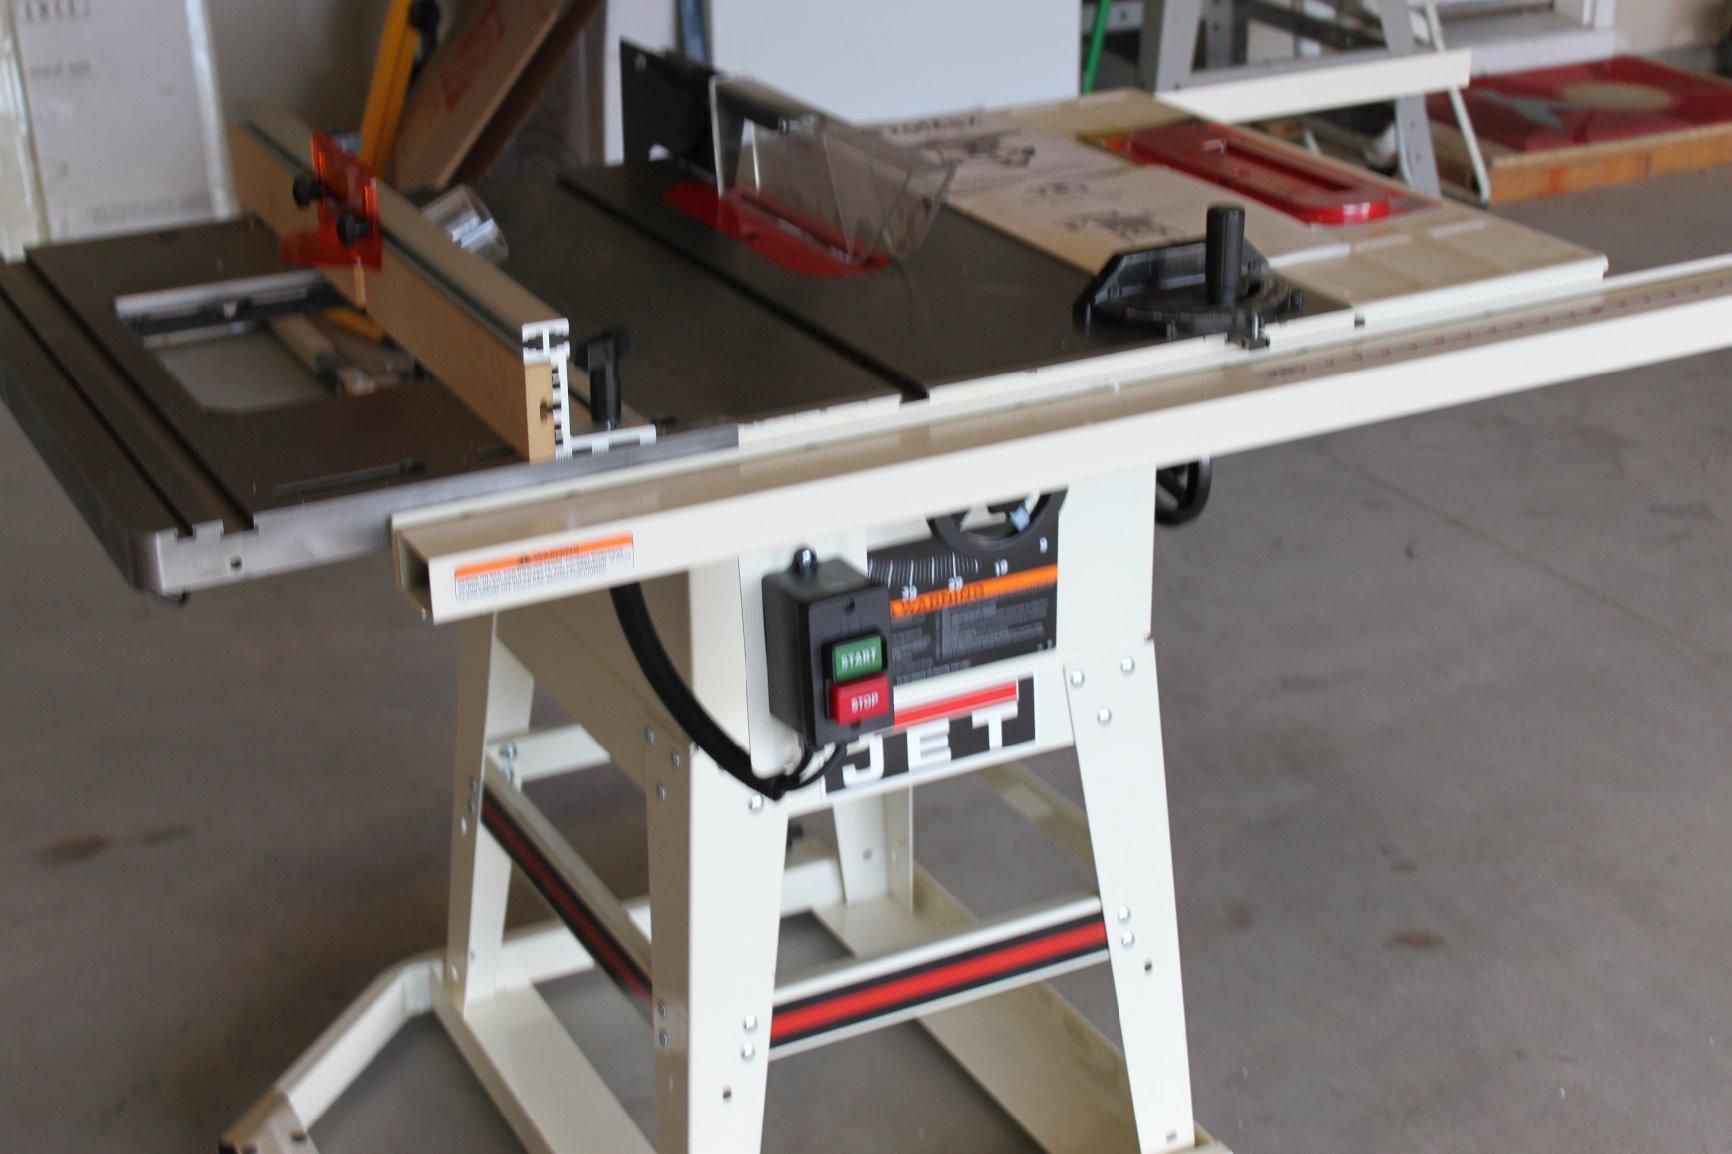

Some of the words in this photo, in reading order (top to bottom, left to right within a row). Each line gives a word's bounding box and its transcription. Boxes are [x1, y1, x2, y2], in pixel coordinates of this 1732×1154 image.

[841, 646, 877, 671] START
[851, 691, 879, 714] STOP
[842, 702, 1018, 785] JET
